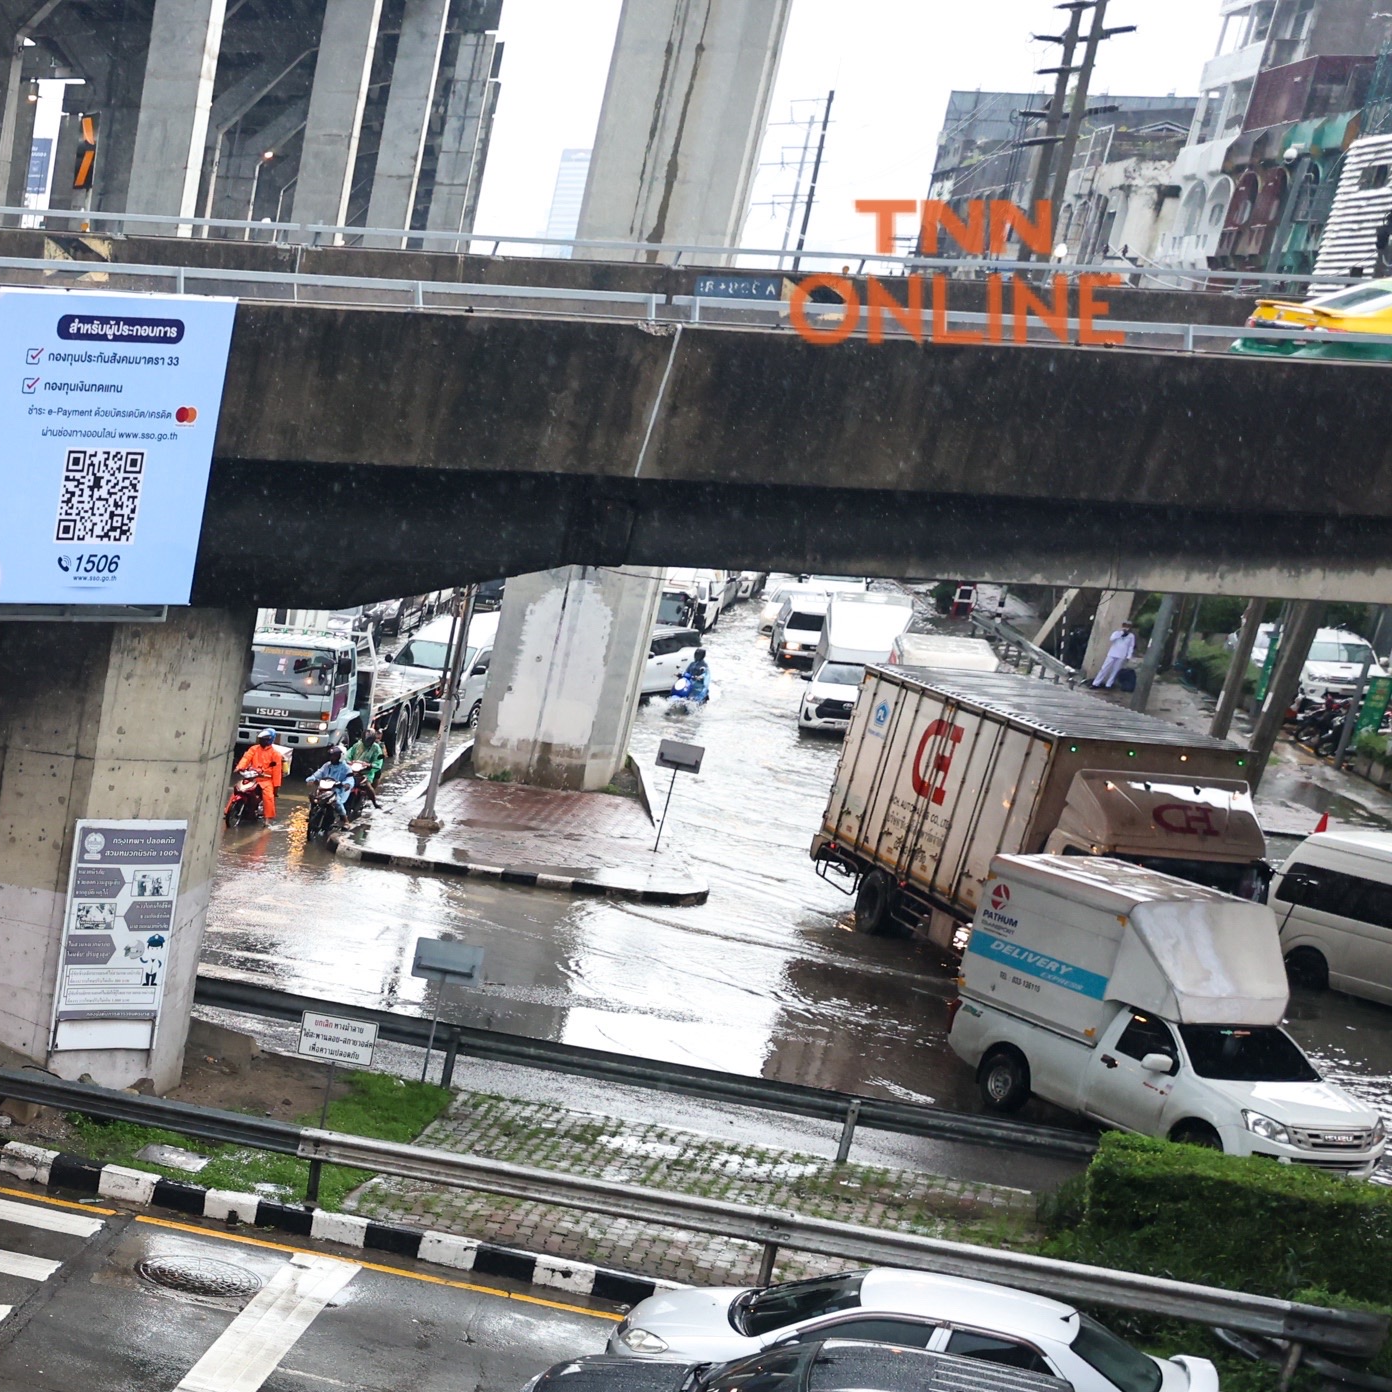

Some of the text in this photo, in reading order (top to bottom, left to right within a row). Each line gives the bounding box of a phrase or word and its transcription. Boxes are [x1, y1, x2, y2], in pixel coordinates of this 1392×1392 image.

[68, 318, 178, 341] สำหรับผู้ประกอบการ
[47, 351, 180, 367] กองทุนประกันสังคมมาตรา 33
[44, 380, 123, 396] กองทุนเงินทดแทน
[47, 407, 93, 419] e-Payment
[118, 431, 178, 441] www.sso.go.th
[76, 554, 121, 573] 1506
[256, 707, 290, 717] ISUZU
[982, 909, 1019, 928] PATHUM
[990, 940, 1073, 975] DELIVERY
